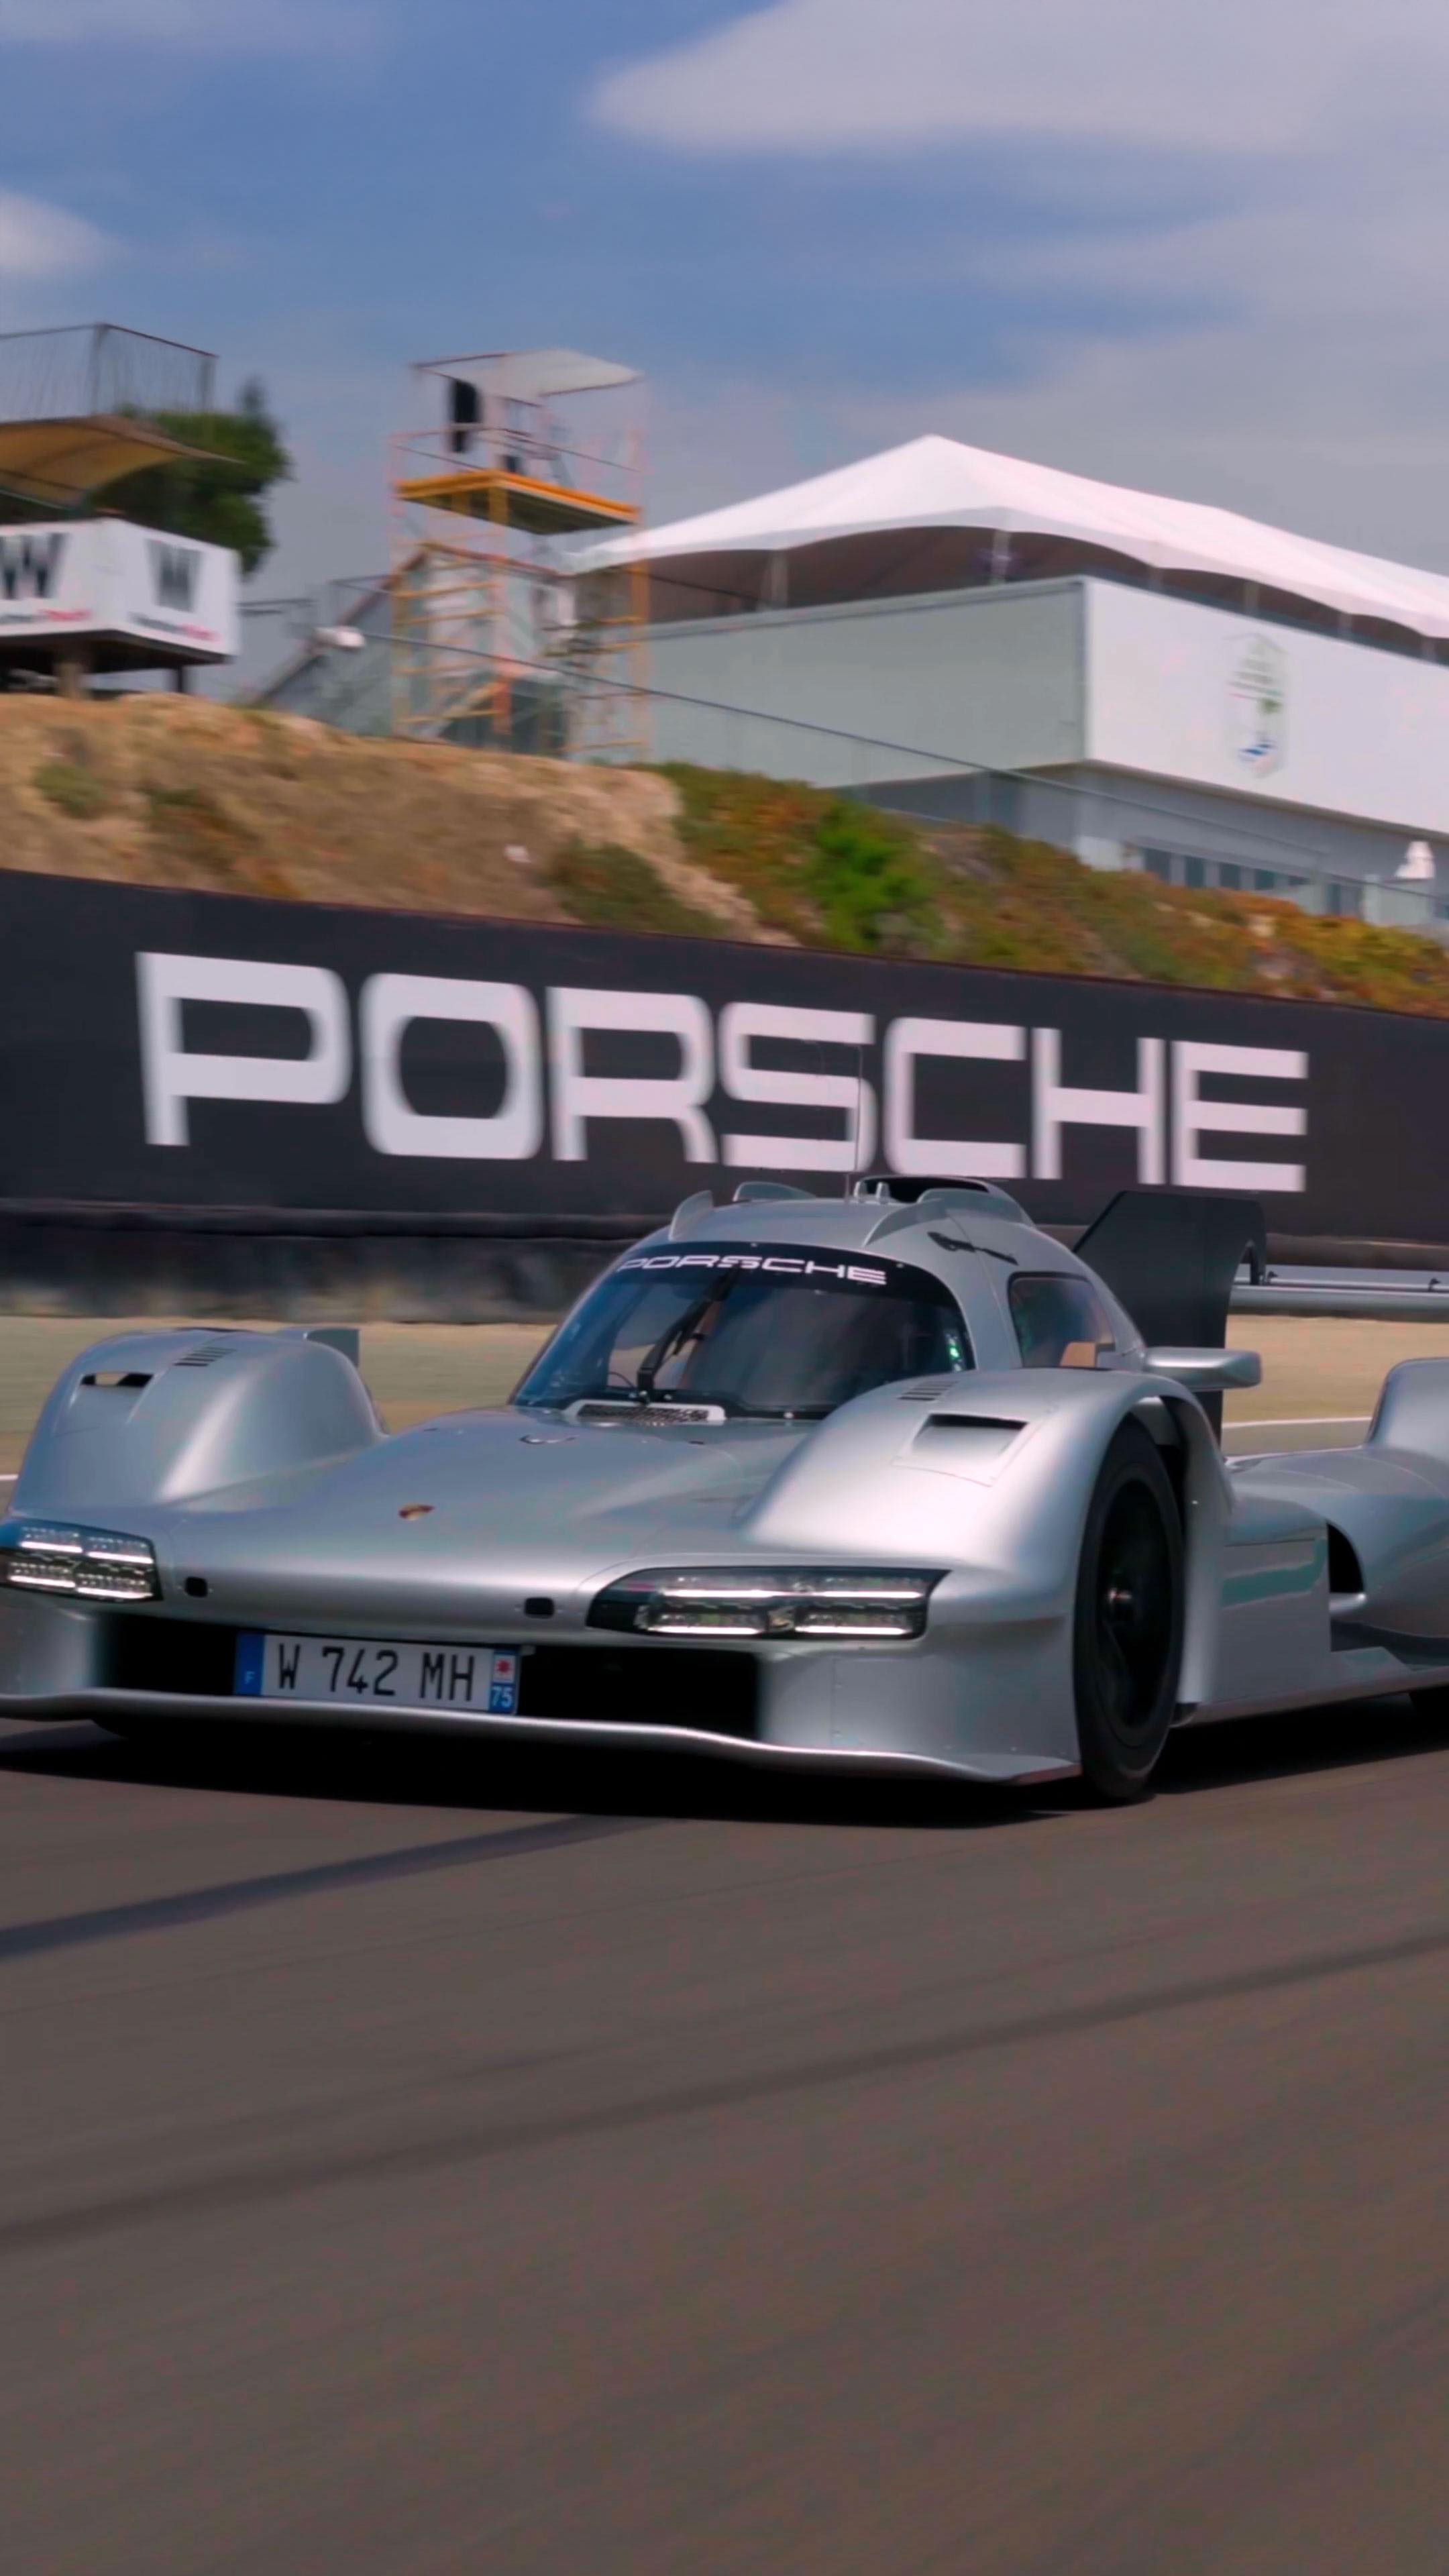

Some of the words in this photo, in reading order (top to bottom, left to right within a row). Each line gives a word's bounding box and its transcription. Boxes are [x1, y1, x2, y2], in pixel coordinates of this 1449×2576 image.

[136, 951, 1308, 1192] PORSCHE
[616, 1255, 886, 1285] PORSCHE
[244, 1671, 255, 1684] F
[278, 1644, 301, 1690] W
[322, 1646, 398, 1696] 742
[420, 1652, 474, 1701] MH
[492, 1686, 513, 1708] 75
